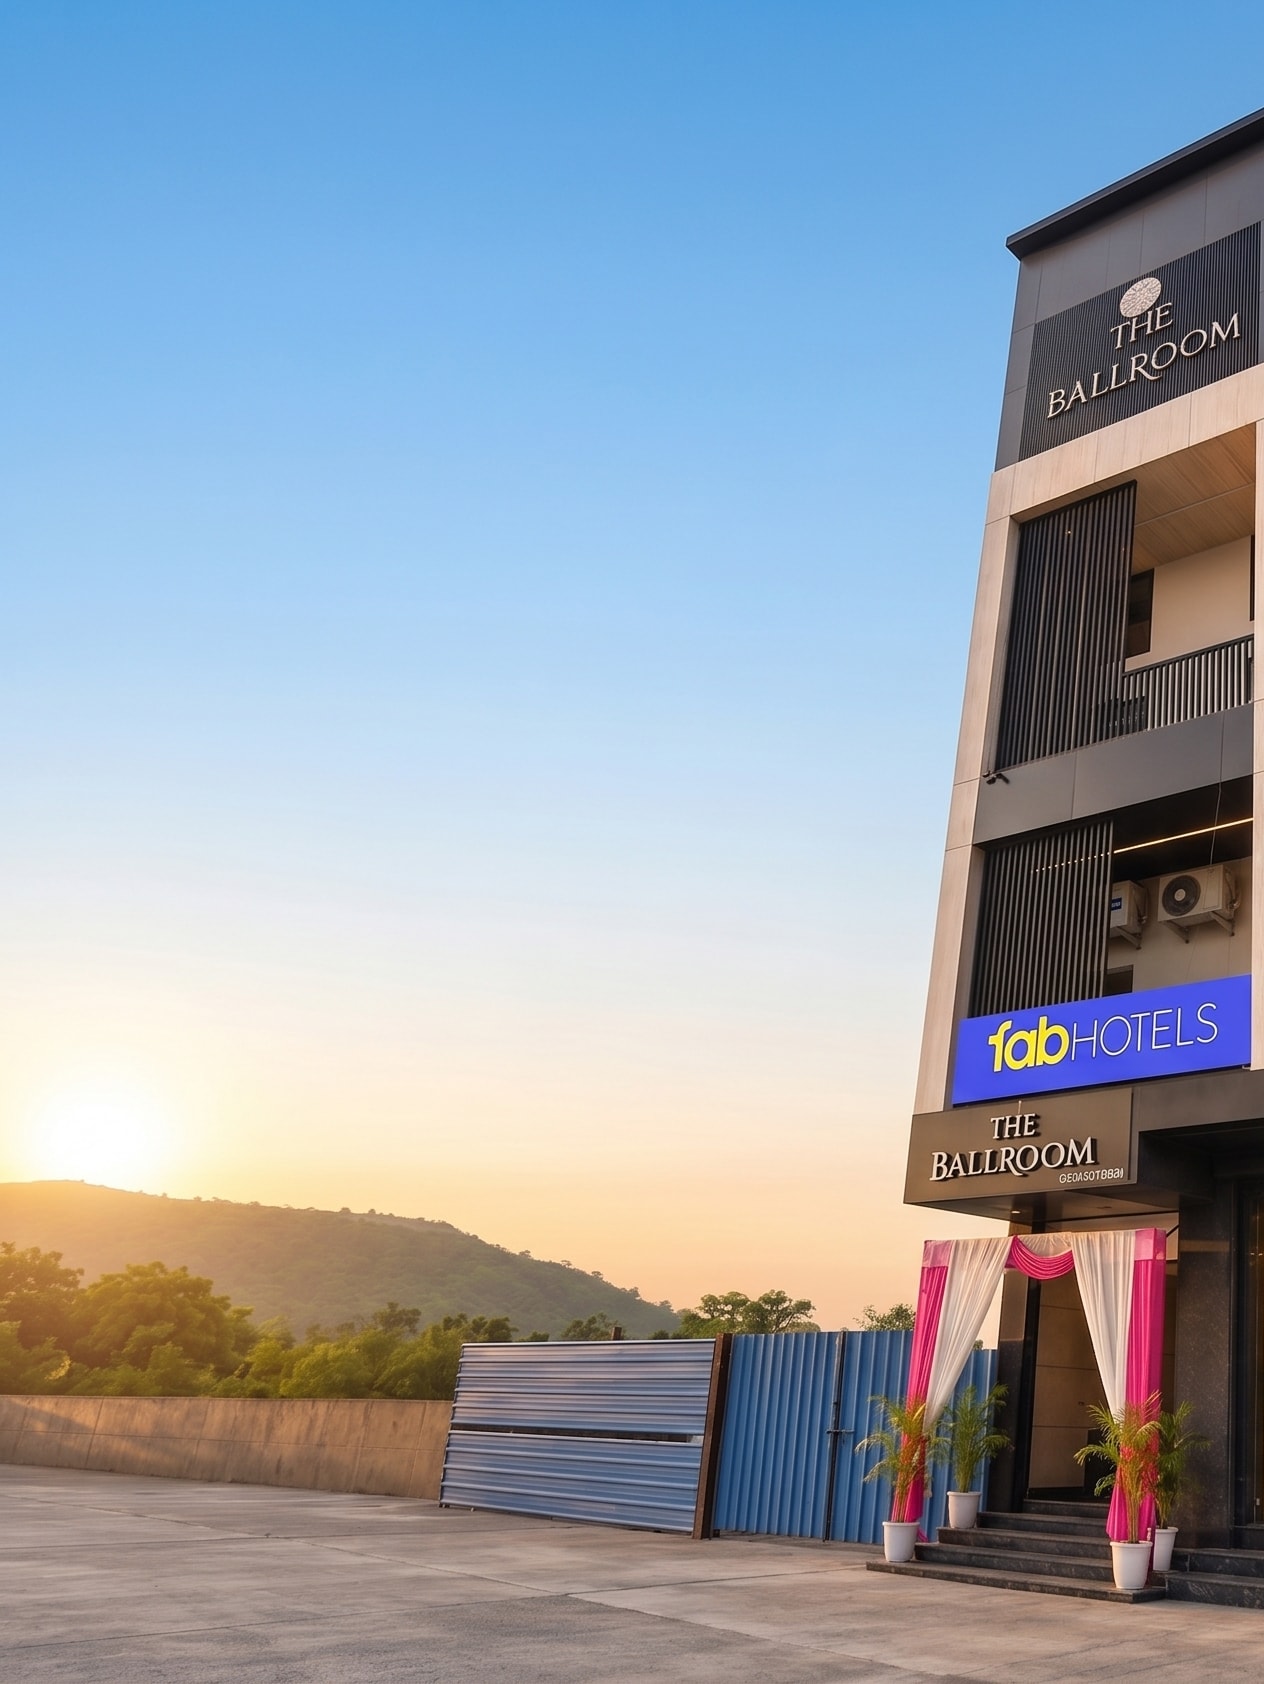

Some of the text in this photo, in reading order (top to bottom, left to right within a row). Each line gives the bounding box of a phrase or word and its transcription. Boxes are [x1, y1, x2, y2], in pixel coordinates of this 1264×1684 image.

[1110, 302, 1174, 350] THE
[1047, 312, 1241, 419] BALLROOM
[990, 1112, 1037, 1141] THE
[929, 1136, 1097, 1182] BALLROOM
